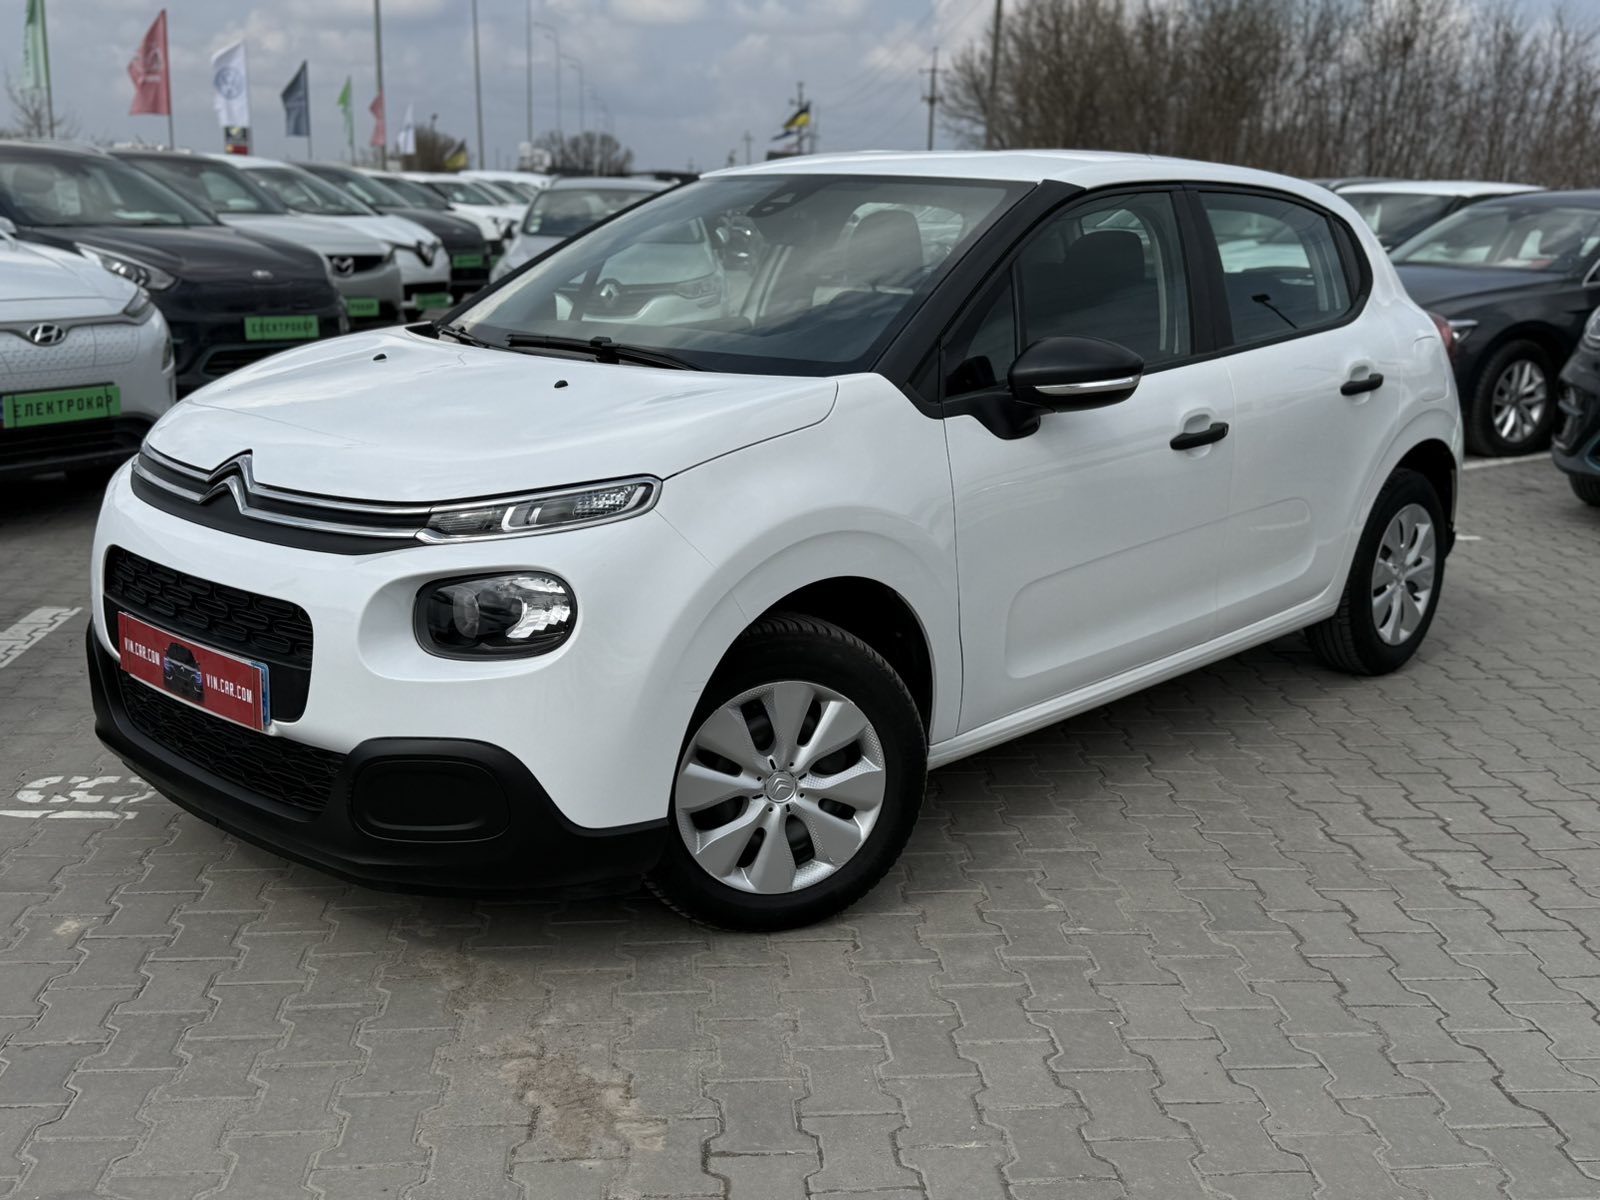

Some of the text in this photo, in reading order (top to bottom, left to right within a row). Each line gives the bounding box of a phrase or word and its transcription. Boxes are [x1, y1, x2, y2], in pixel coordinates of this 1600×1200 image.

[14, 395, 113, 418] ЕЛЕКТРОКАР
[124, 637, 160, 666] VIN.CAR.COM
[206, 673, 253, 704] VIN.CAR.COM
